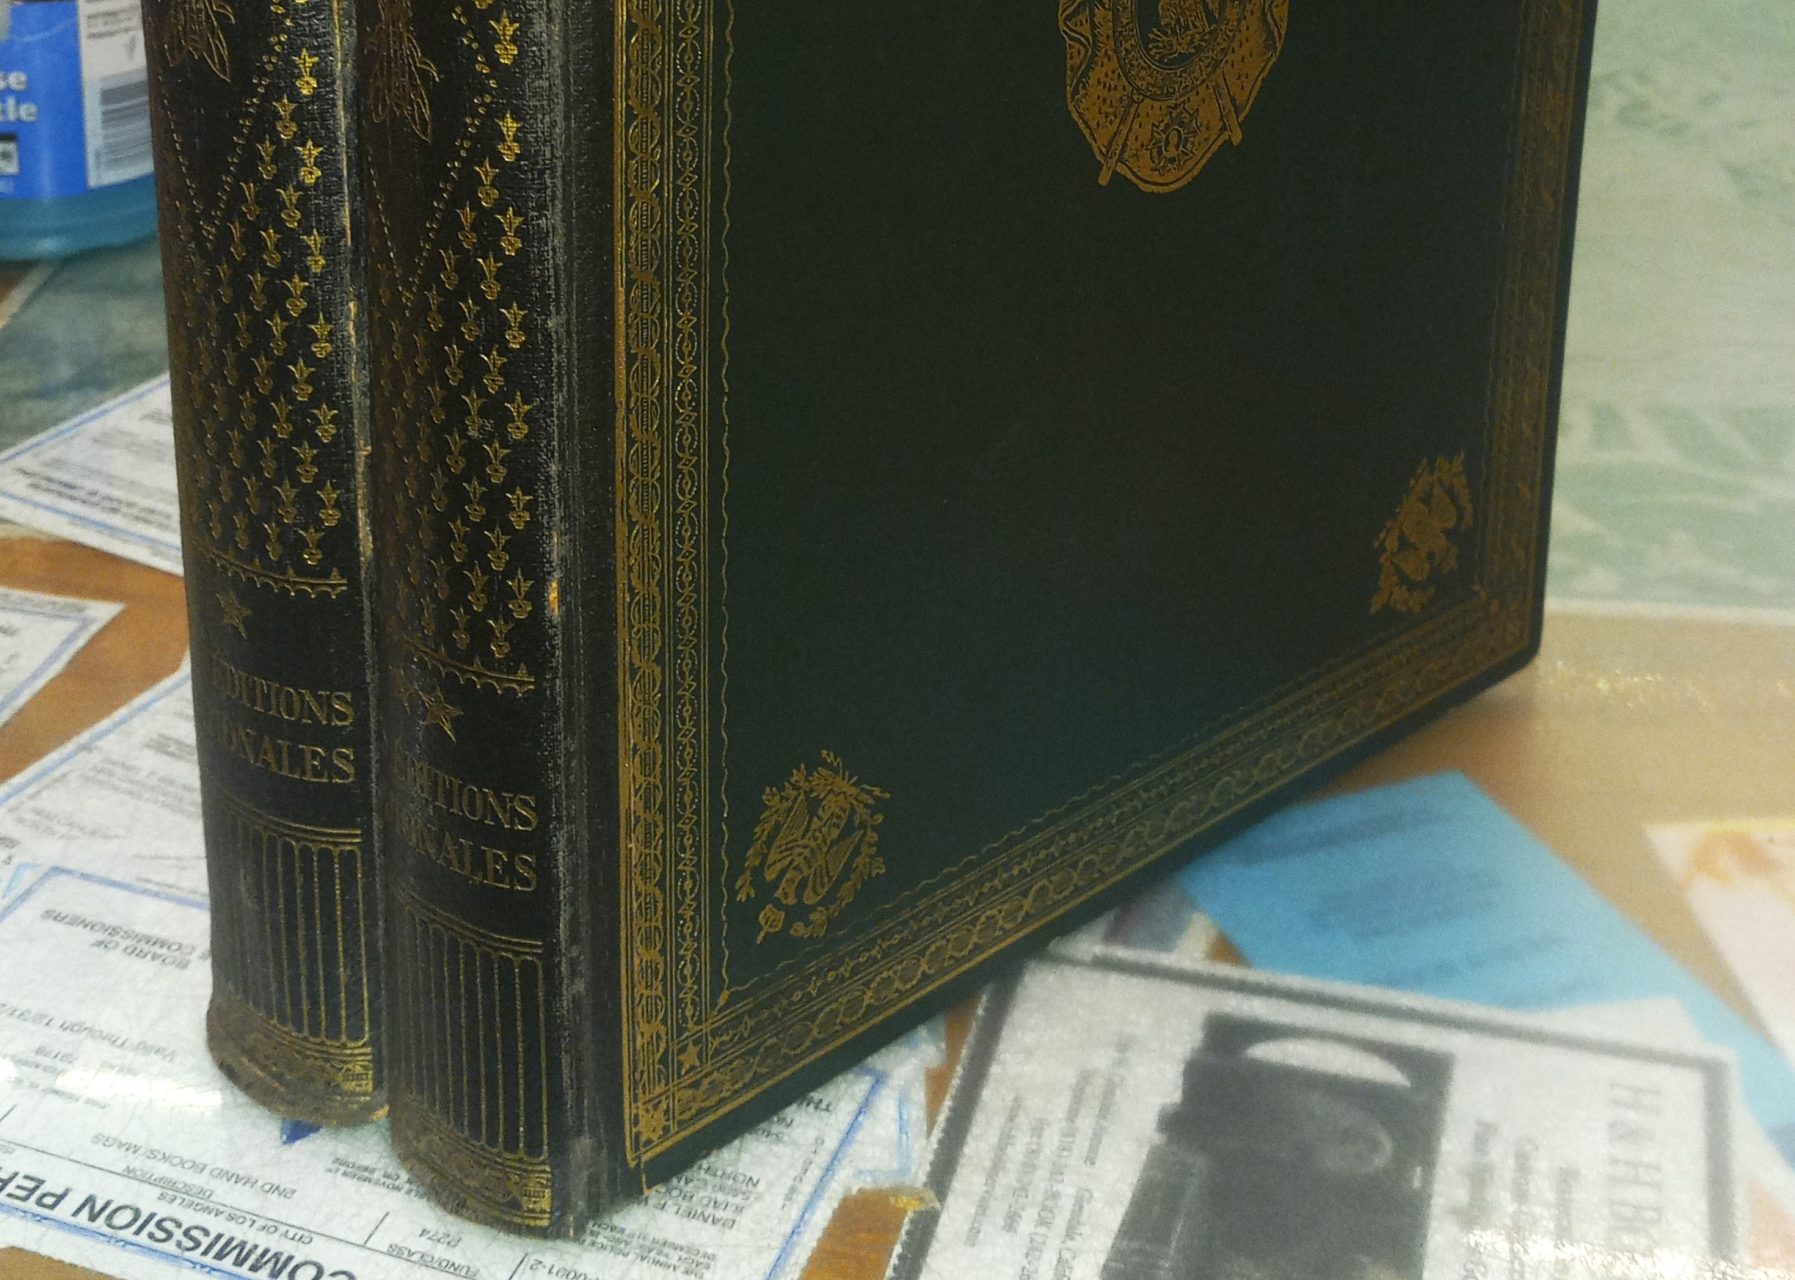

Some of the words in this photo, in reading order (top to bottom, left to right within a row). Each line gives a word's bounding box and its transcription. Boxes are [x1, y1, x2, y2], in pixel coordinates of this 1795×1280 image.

[41, 909, 196, 956] COMMISSIONERS
[91, 938, 120, 951] OF
[123, 943, 191, 970] BOARD
[60, 1020, 129, 1048] Through
[91, 1133, 142, 1156] MAGS
[121, 1165, 215, 1199] DESCRIPTION
[209, 1166, 261, 1189] HAND
[263, 1182, 297, 1200] 2ND
[157, 1191, 226, 1219] ANGELES
[671, 1201, 737, 1230] DANIEL
[227, 1212, 256, 1226] LOS
[257, 1222, 279, 1235] OF
[279, 1230, 314, 1246] CITY
[387, 1243, 481, 1279] FUND/CLASS
